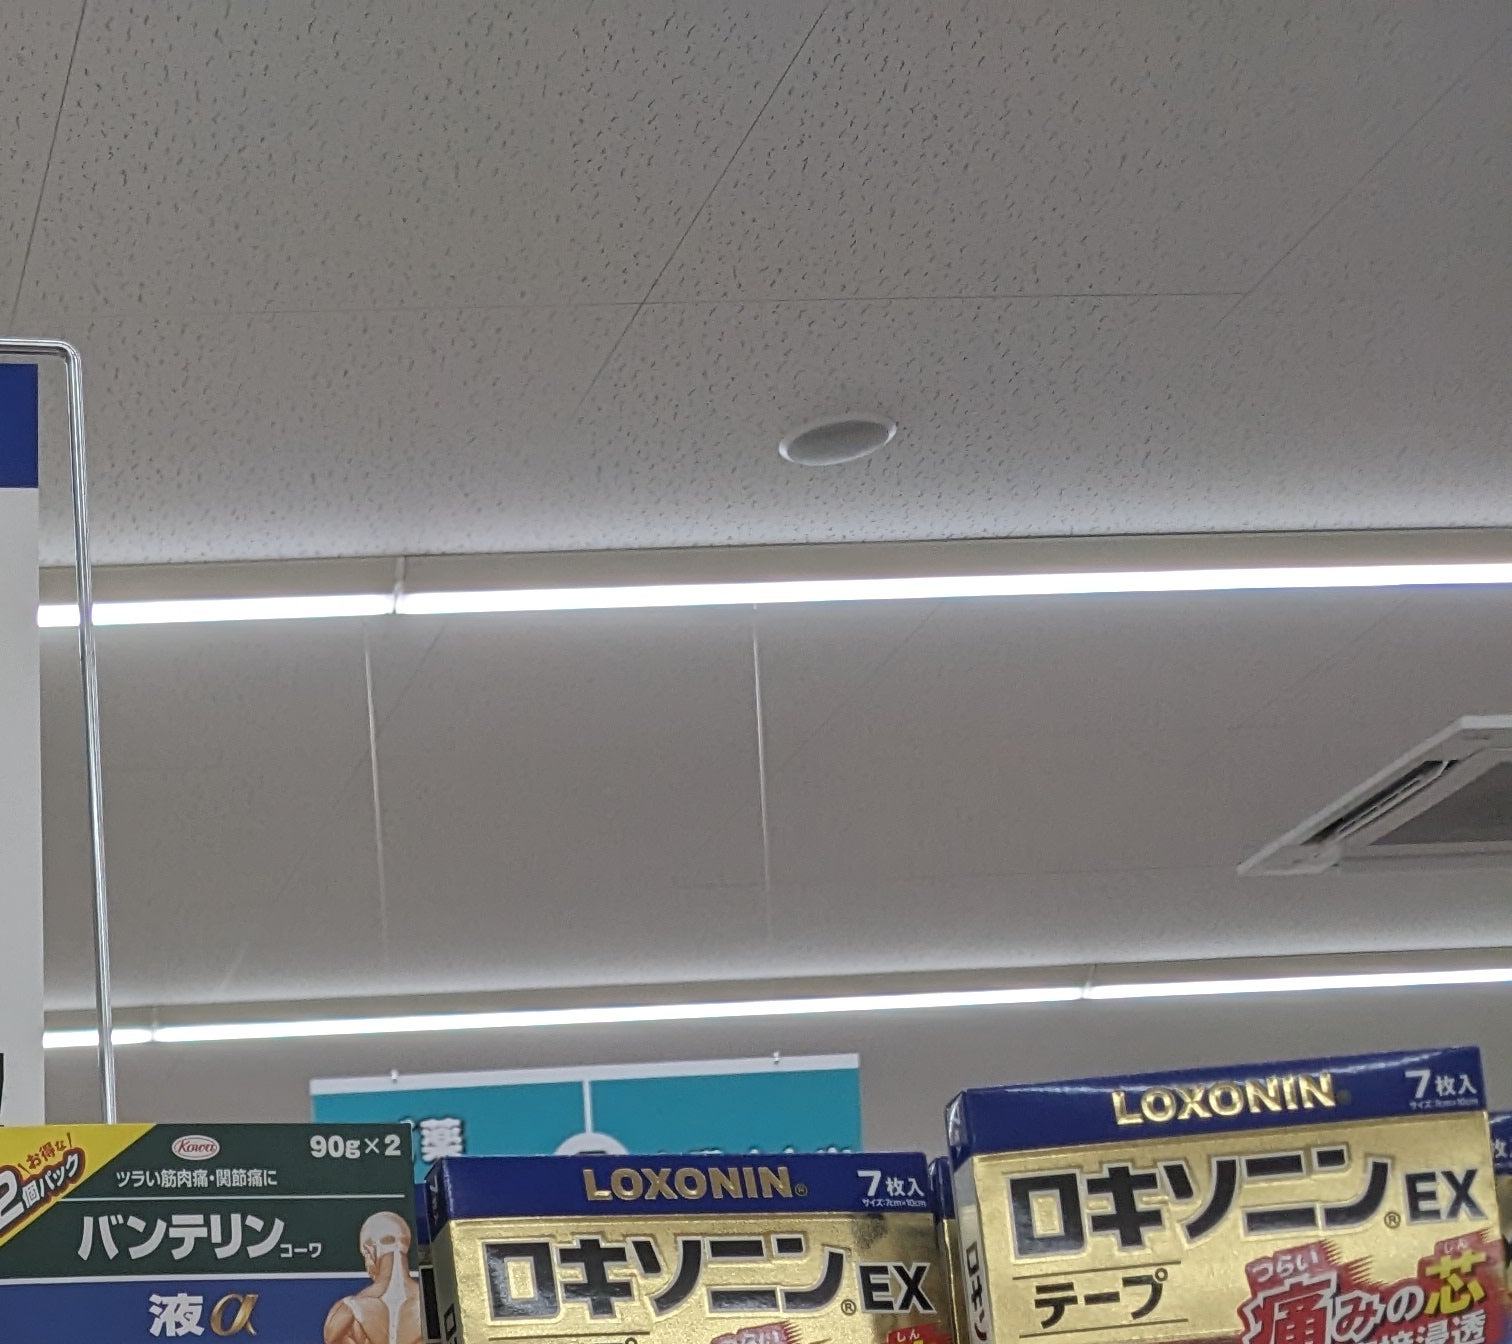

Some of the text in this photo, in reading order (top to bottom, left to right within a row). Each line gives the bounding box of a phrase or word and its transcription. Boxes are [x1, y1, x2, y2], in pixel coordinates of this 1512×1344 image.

[1112, 1073, 1336, 1126] LOXONIN
[310, 1135, 401, 1160] 90g×2
[117, 1168, 278, 1188] ツラい筋肉痛・関節痛に
[582, 1167, 791, 1200] LOXONIN
[857, 1170, 925, 1197] 7枚入
[1033, 1267, 1169, 1328] テープ
